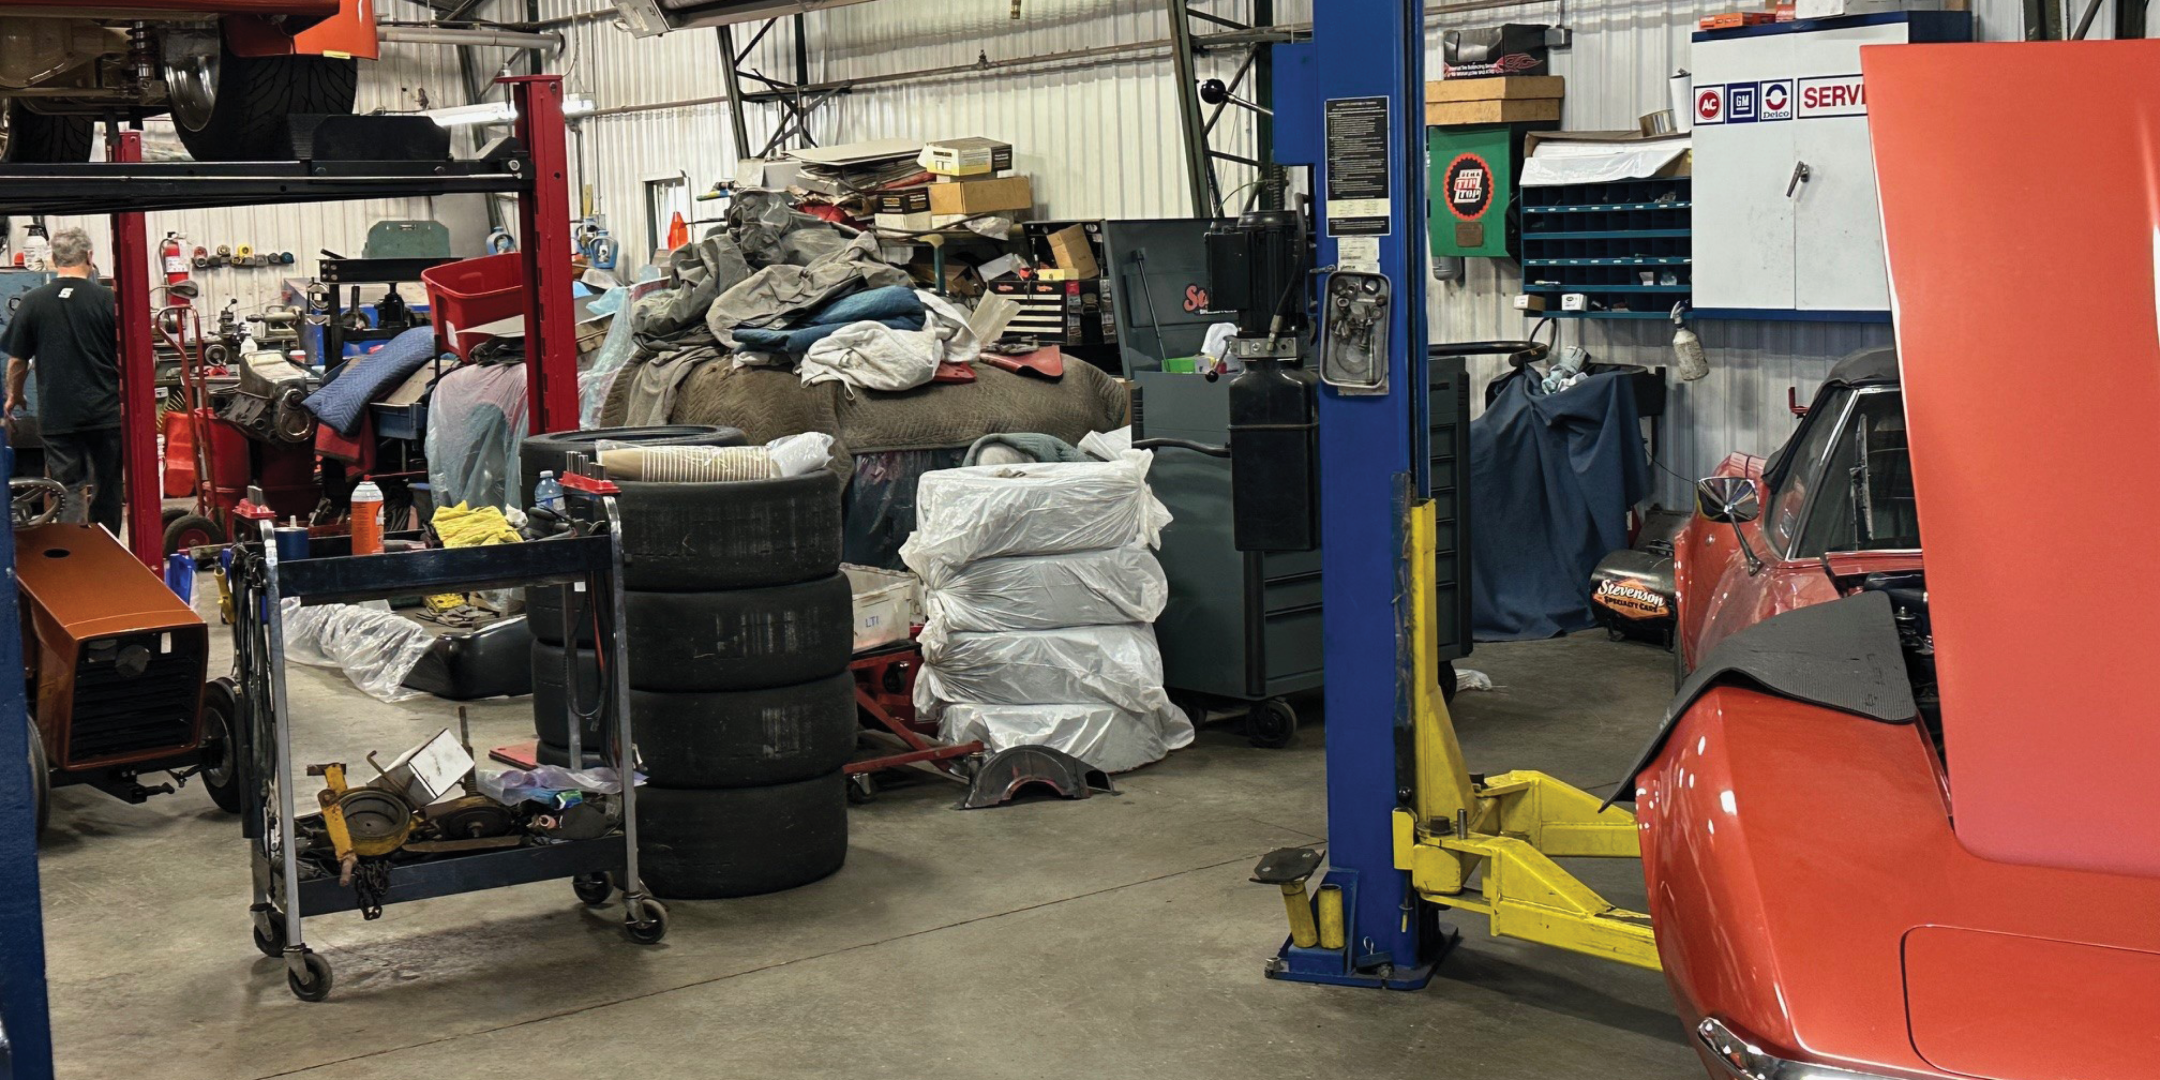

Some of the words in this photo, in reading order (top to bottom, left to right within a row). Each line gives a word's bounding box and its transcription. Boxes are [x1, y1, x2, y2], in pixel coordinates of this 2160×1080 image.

[1736, 95, 1749, 107] GM
[1804, 84, 1866, 108] SERVI
[1701, 98, 1718, 111] AC
[1763, 111, 1790, 119] Delco
[1597, 579, 1665, 606] Stevenson
